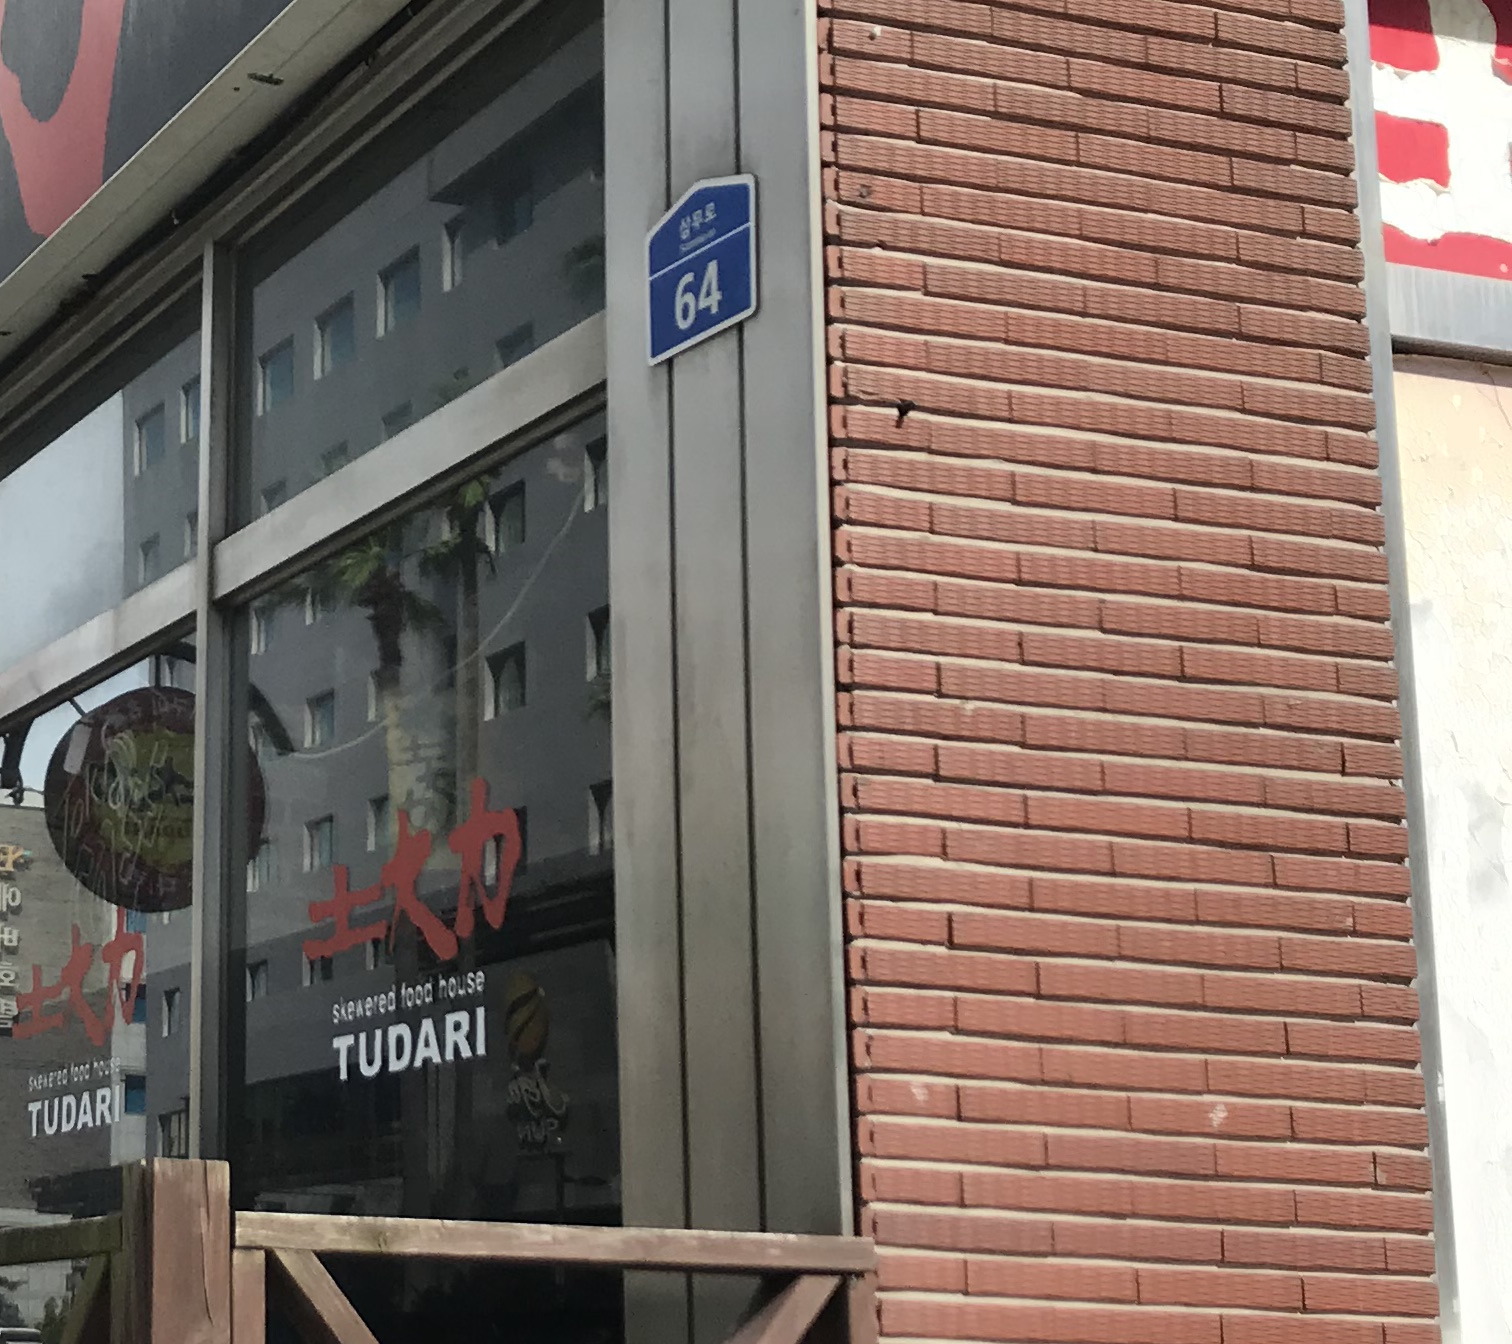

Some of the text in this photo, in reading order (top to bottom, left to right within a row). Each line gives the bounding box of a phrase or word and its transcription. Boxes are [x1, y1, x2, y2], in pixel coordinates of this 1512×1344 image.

[674, 259, 722, 330] 64
[331, 983, 396, 1024] skewered
[438, 969, 486, 1002] house
[332, 1006, 487, 1082] TUDARI
[28, 1084, 120, 1137] TUDARI
